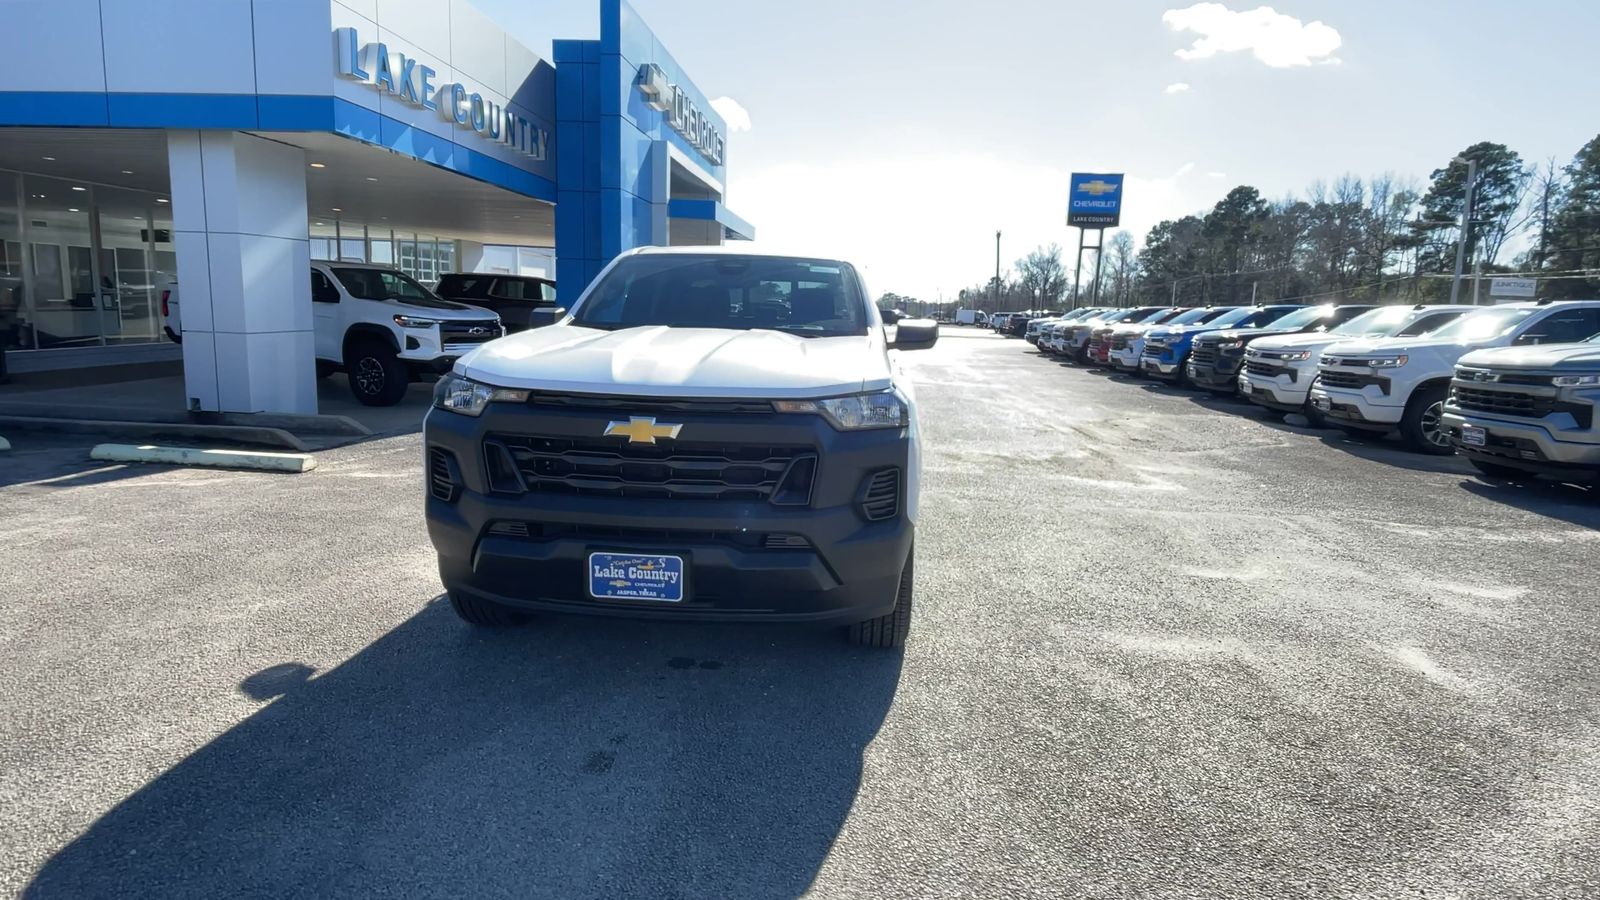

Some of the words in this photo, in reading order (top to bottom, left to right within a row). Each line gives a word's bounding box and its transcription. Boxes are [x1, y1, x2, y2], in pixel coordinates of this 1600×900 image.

[341, 27, 438, 112] LAKE
[445, 83, 549, 161] COUNTRY
[672, 84, 724, 165] CHEVROLET
[1073, 200, 1117, 208] CHEVROLET
[594, 563, 625, 579] Lake
[628, 566, 679, 584] Country
